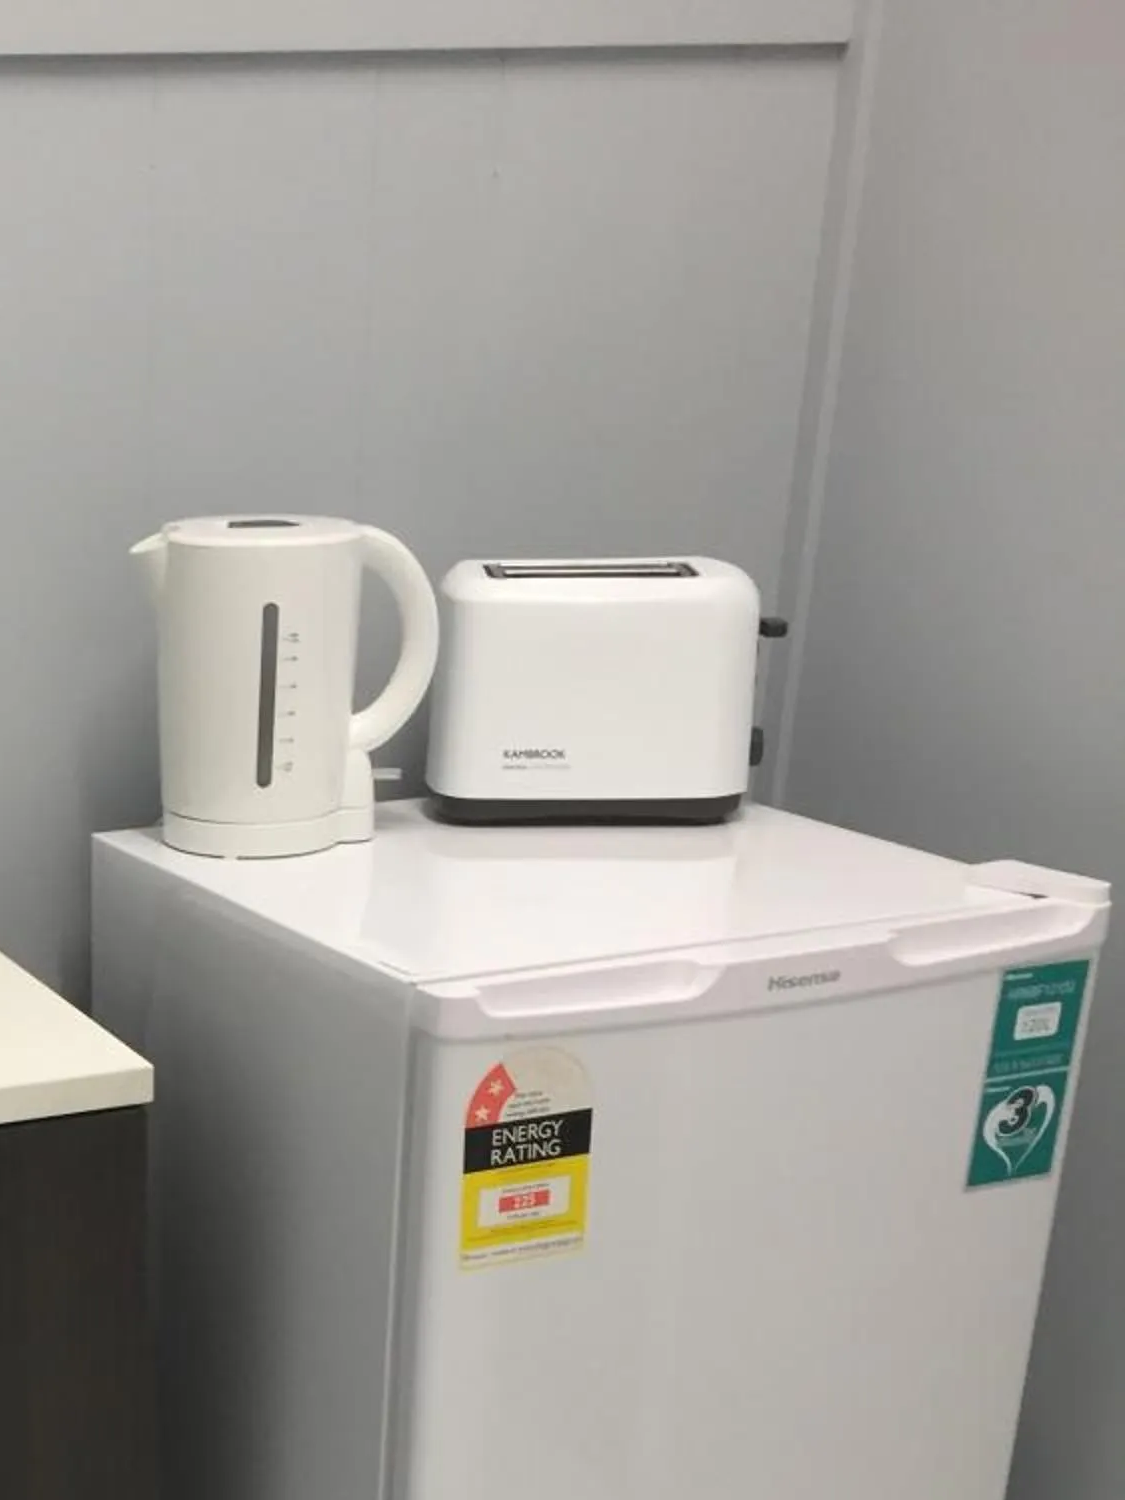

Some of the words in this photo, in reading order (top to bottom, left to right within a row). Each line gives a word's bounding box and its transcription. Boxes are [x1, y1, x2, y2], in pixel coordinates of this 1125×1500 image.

[502, 748, 566, 760] KAMBROOK
[767, 970, 841, 992] Hisense
[998, 1087, 1034, 1136] 3
[492, 1119, 564, 1147] ENERGY
[490, 1139, 562, 1166] RATING
